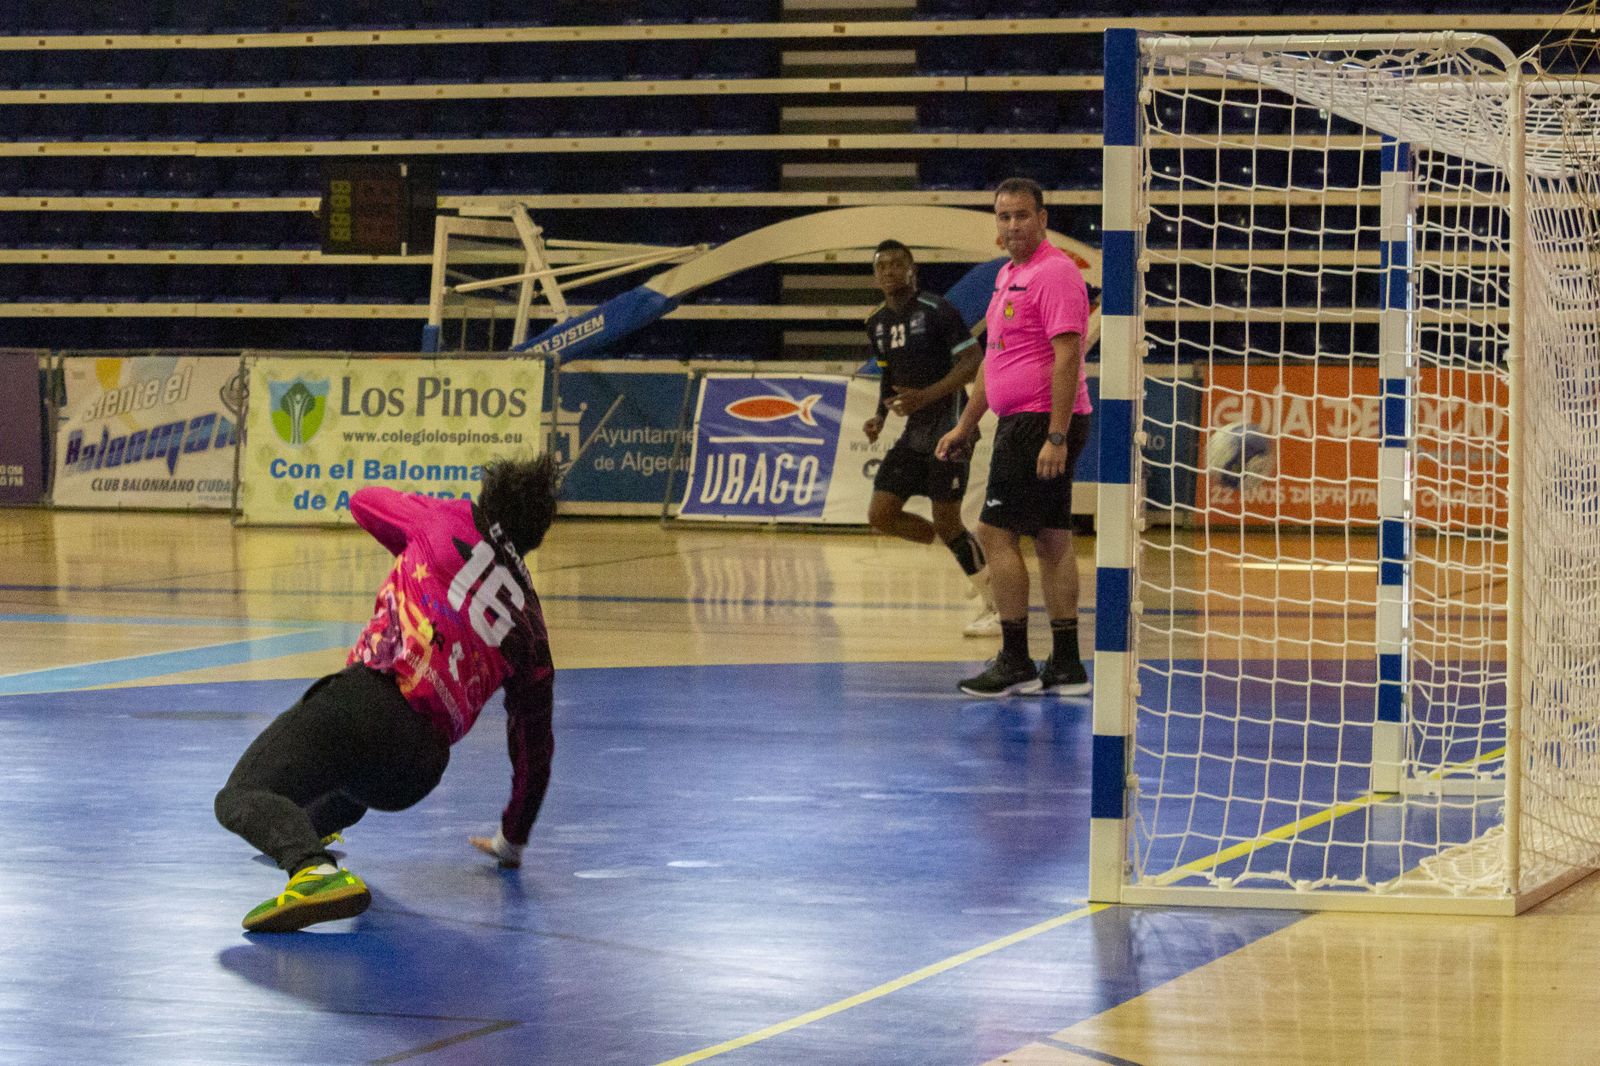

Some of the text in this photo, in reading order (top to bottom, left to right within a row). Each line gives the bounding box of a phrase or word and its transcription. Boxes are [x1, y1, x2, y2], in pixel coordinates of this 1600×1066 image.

[551, 314, 605, 349] SYSTEM
[165, 366, 192, 405] el
[340, 376, 527, 418] Los Pinos
[1322, 398, 1379, 437] DE
[64, 412, 238, 477] Balonman
[343, 429, 523, 446] www.colegiolospinos.eu
[594, 427, 694, 447] Ayuntamie
[270, 458, 483, 480] Con el Balonma
[594, 451, 690, 476] de Algecir
[91, 478, 233, 492] CLUB BALONMANO CIUDA
[700, 453, 819, 505] UBAGO
[293, 490, 327, 510] de
[1211, 485, 1233, 504] 22
[1289, 485, 1379, 506] DISFRUTA
[447, 540, 525, 647] 16
